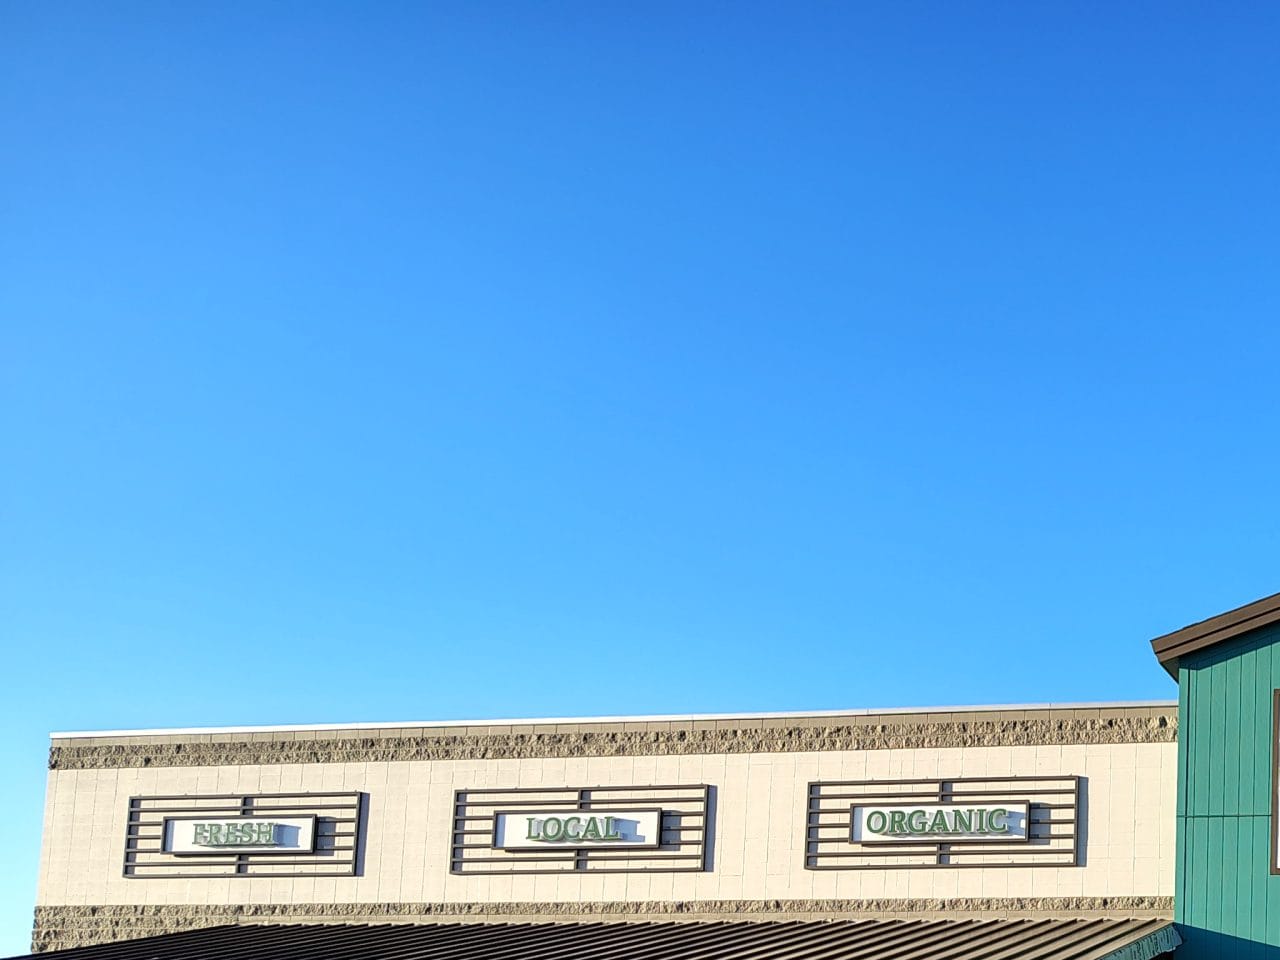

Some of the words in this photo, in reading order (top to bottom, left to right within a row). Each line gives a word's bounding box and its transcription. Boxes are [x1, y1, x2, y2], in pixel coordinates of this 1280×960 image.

[192, 821, 277, 846] FRESH
[525, 815, 620, 842] LOCAL
[866, 808, 1010, 836] ORGANIC
